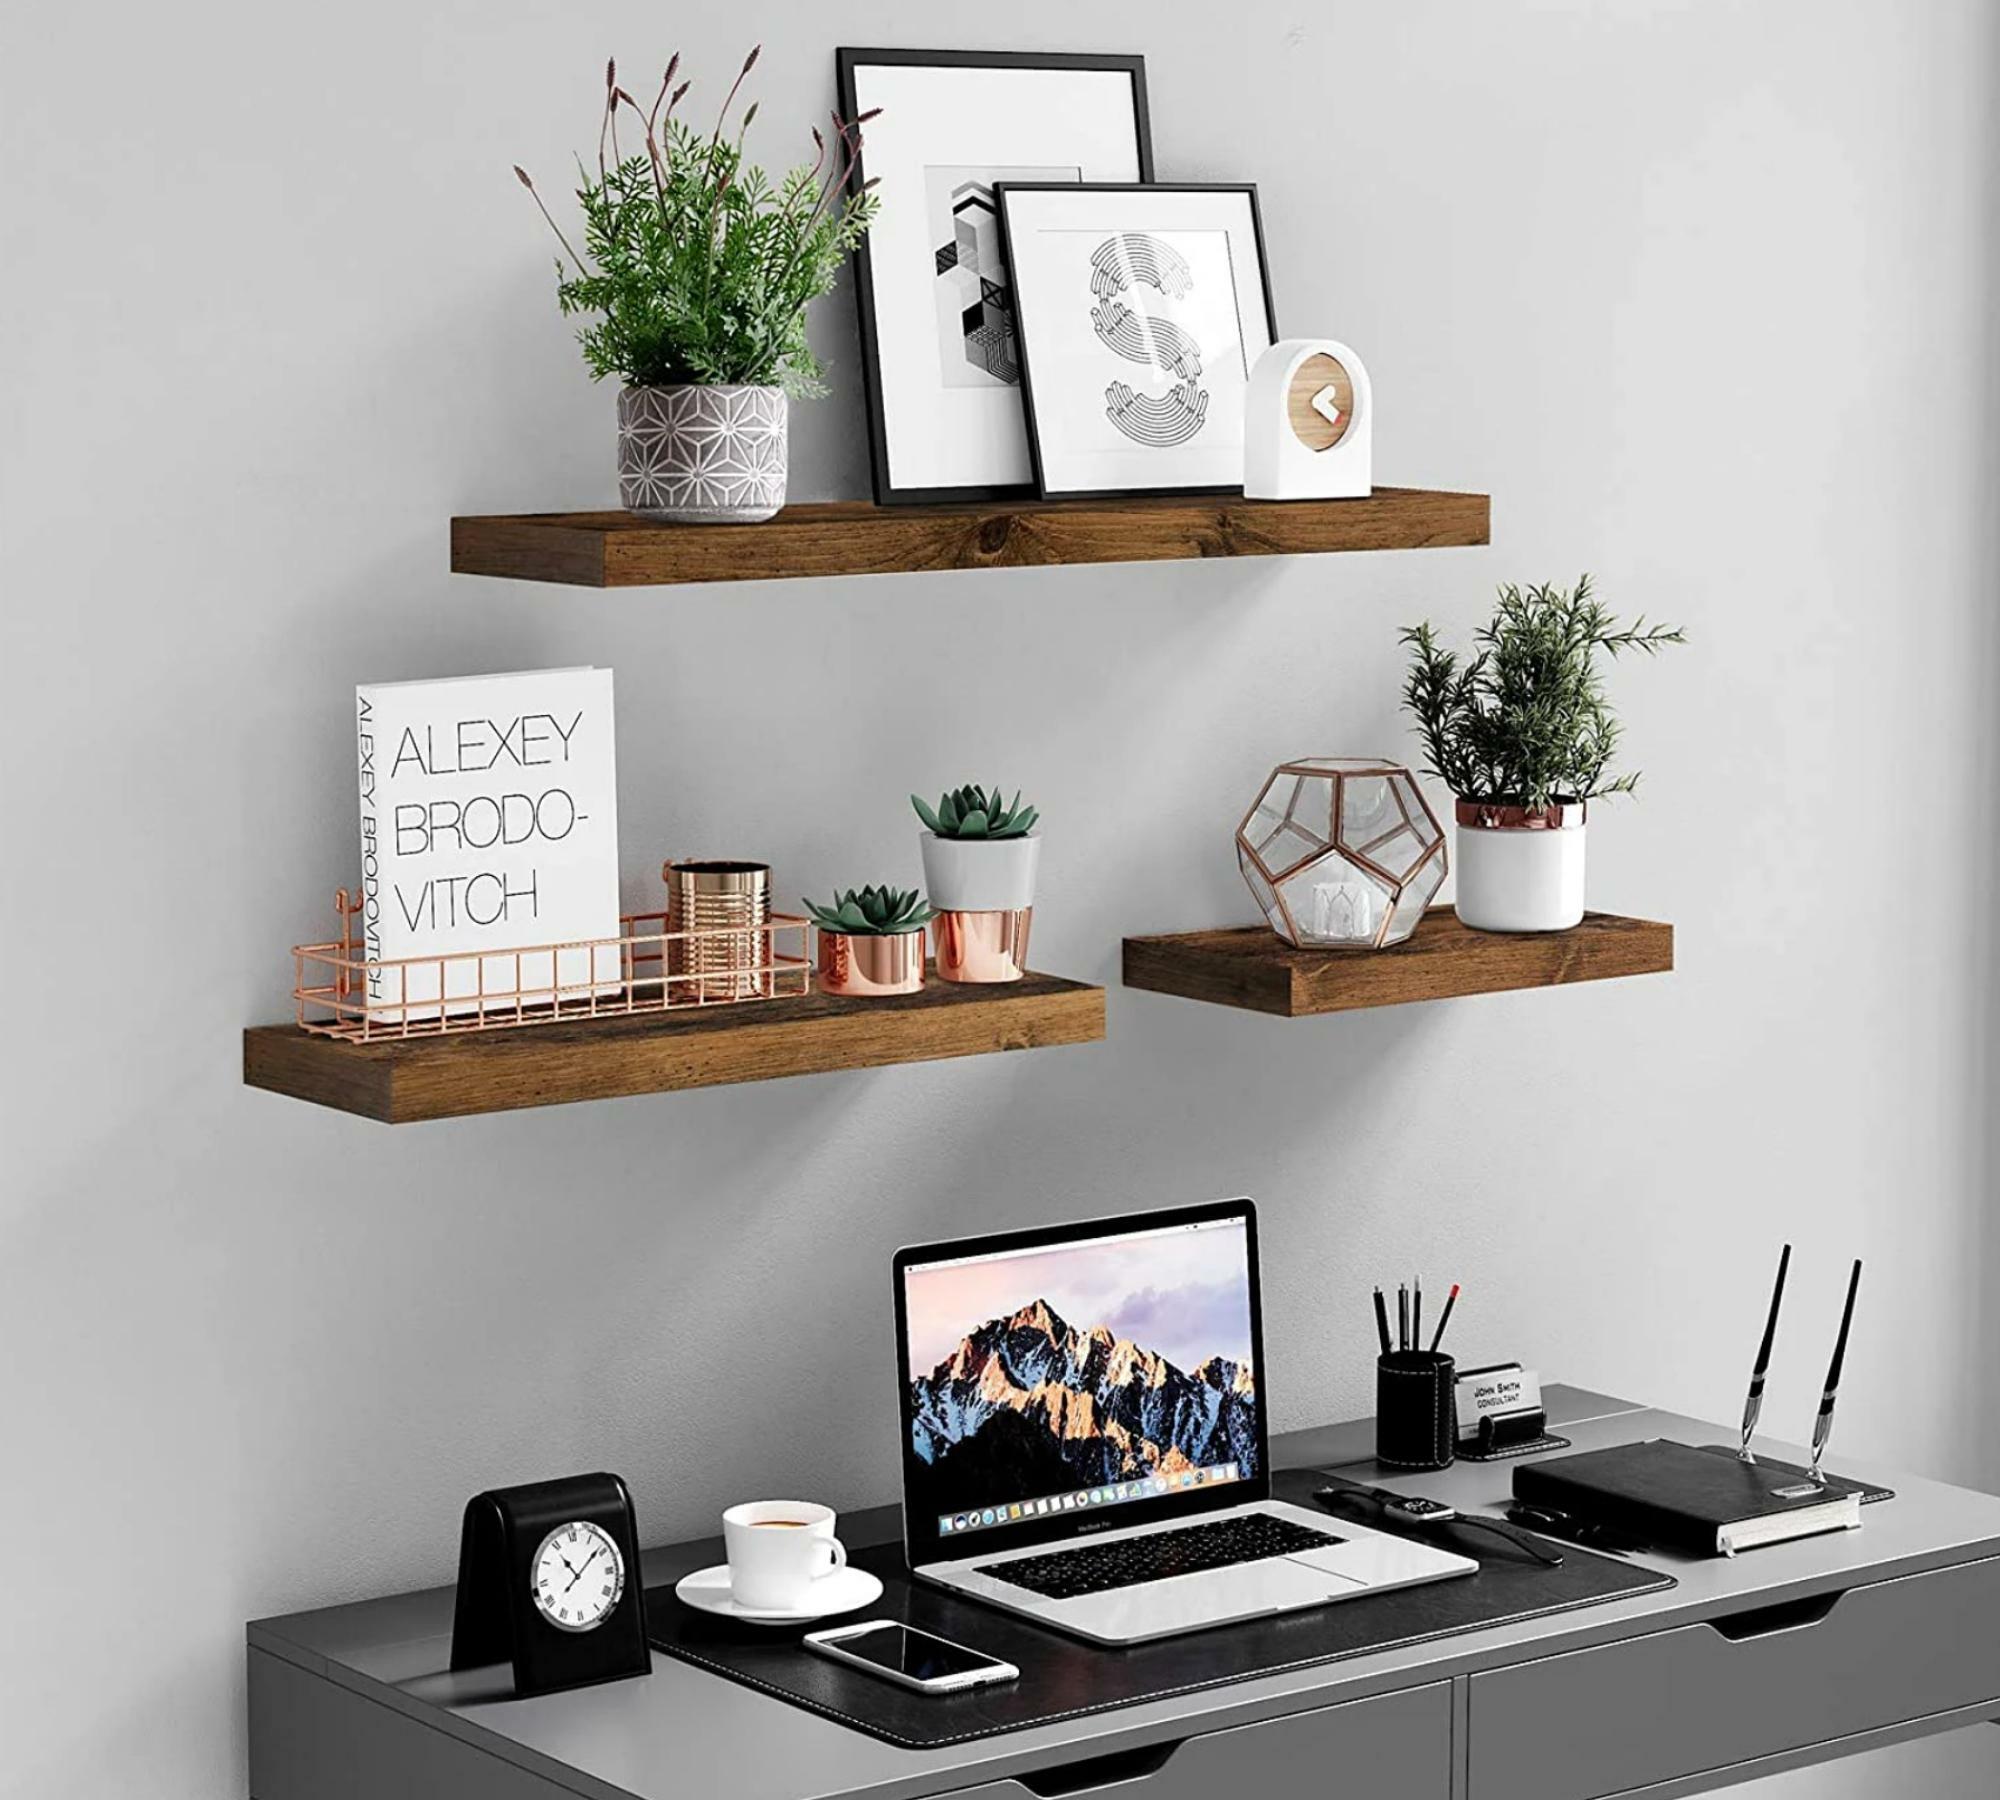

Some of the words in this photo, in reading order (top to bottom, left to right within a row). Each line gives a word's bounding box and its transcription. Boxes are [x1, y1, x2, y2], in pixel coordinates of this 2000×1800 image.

[358, 695, 376, 808] ALEXEY
[390, 710, 584, 779] ALEXEY
[394, 788, 589, 857] BRODO-
[362, 815, 383, 1000] BRODOVITCH
[393, 868, 539, 933] VITCH
[1474, 1386, 1495, 1398] JOHN
[1496, 1382, 1521, 1394] SMITH
[1477, 1393, 1520, 1409] CONSULTANT
